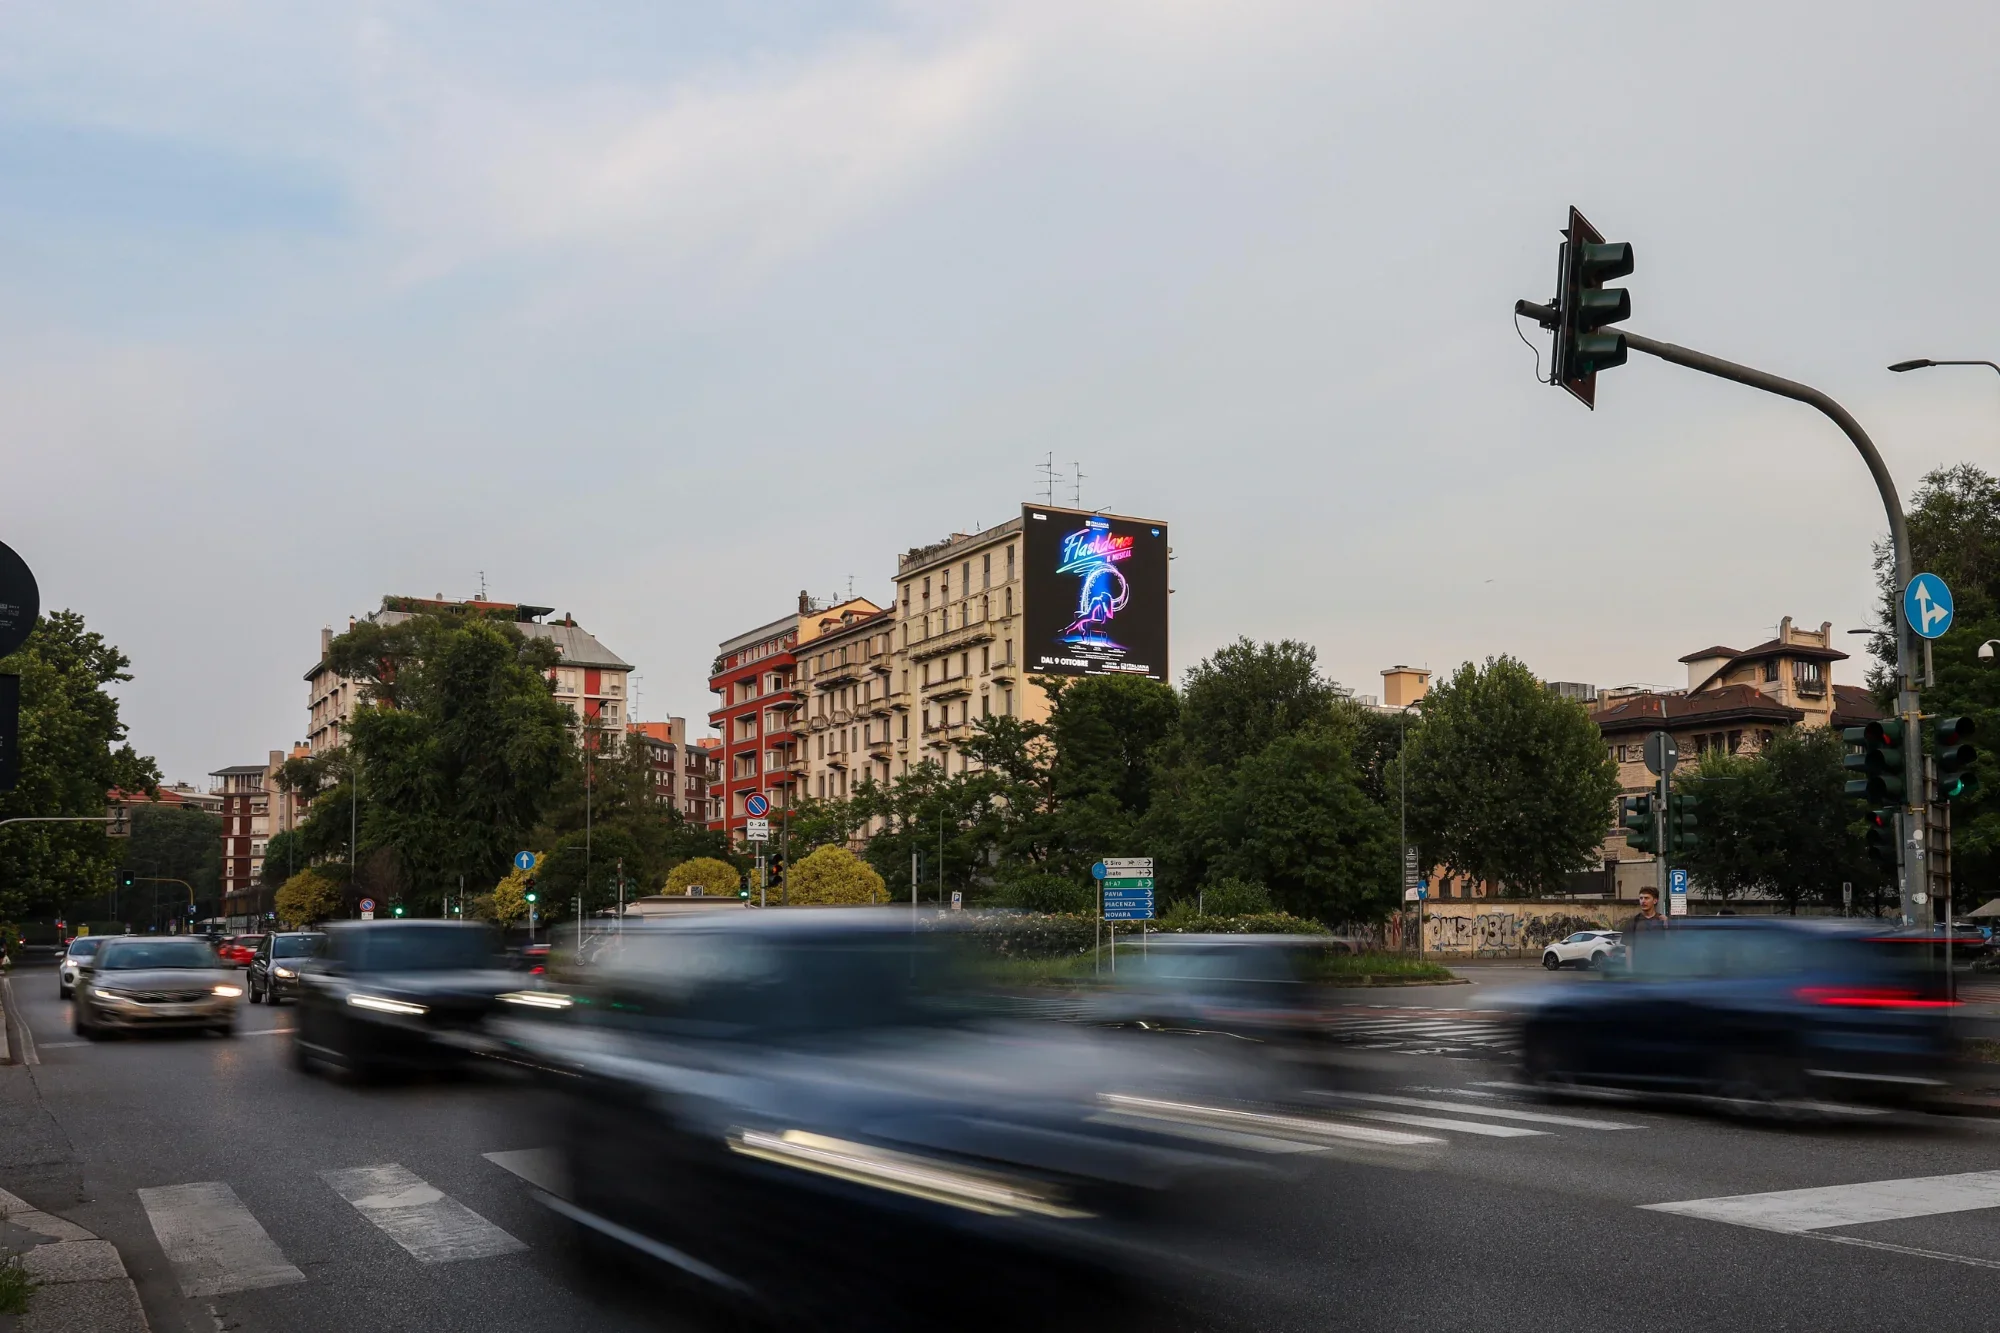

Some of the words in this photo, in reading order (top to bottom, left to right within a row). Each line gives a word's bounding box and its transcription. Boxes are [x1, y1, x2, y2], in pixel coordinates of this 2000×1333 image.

[1063, 529, 1134, 563] Flashdance
[1041, 656, 1054, 664] DAL
[1060, 657, 1089, 667] OTTOBRE
[1674, 874, 1684, 886] P
